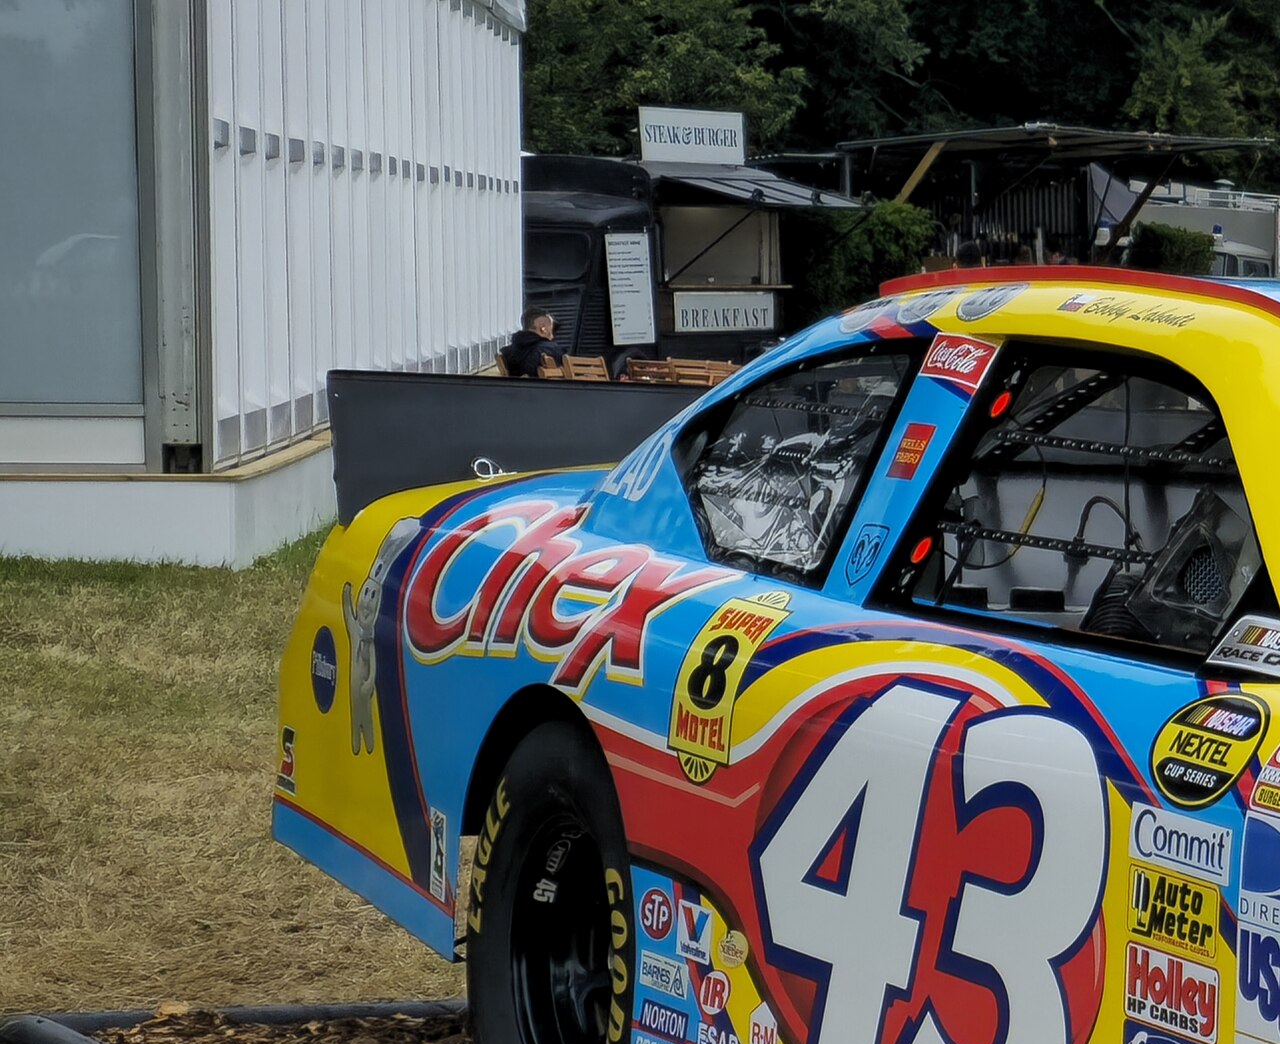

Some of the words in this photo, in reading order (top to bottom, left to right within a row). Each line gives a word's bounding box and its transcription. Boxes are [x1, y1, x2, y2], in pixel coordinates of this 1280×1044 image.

[645, 124, 681, 144] STEAK
[694, 128, 738, 148] BURGER
[681, 308, 769, 328] BREAKFAST
[404, 501, 743, 697] Chex
[709, 608, 774, 645] SUPER
[688, 635, 739, 710] 8
[1217, 647, 1262, 662] RACE
[676, 701, 725, 752] MOTEL
[1203, 709, 1256, 736] NASCAR
[1169, 730, 1232, 767] NEXTEL
[1164, 763, 1185, 778] CUP
[1184, 769, 1217, 788] SERIES
[468, 777, 511, 934] EAGLE
[1134, 809, 1225, 870] Commit
[644, 895, 669, 930] STP
[1154, 875, 1203, 915] Auto
[1150, 902, 1212, 946] Meter
[642, 961, 670, 986] BARNES
[1128, 946, 1216, 1037] Holley
[704, 976, 725, 1009] IR
[642, 1003, 685, 1039] NORTON
[1127, 997, 1146, 1016] HP
[1150, 1002, 1198, 1033] CARBS
